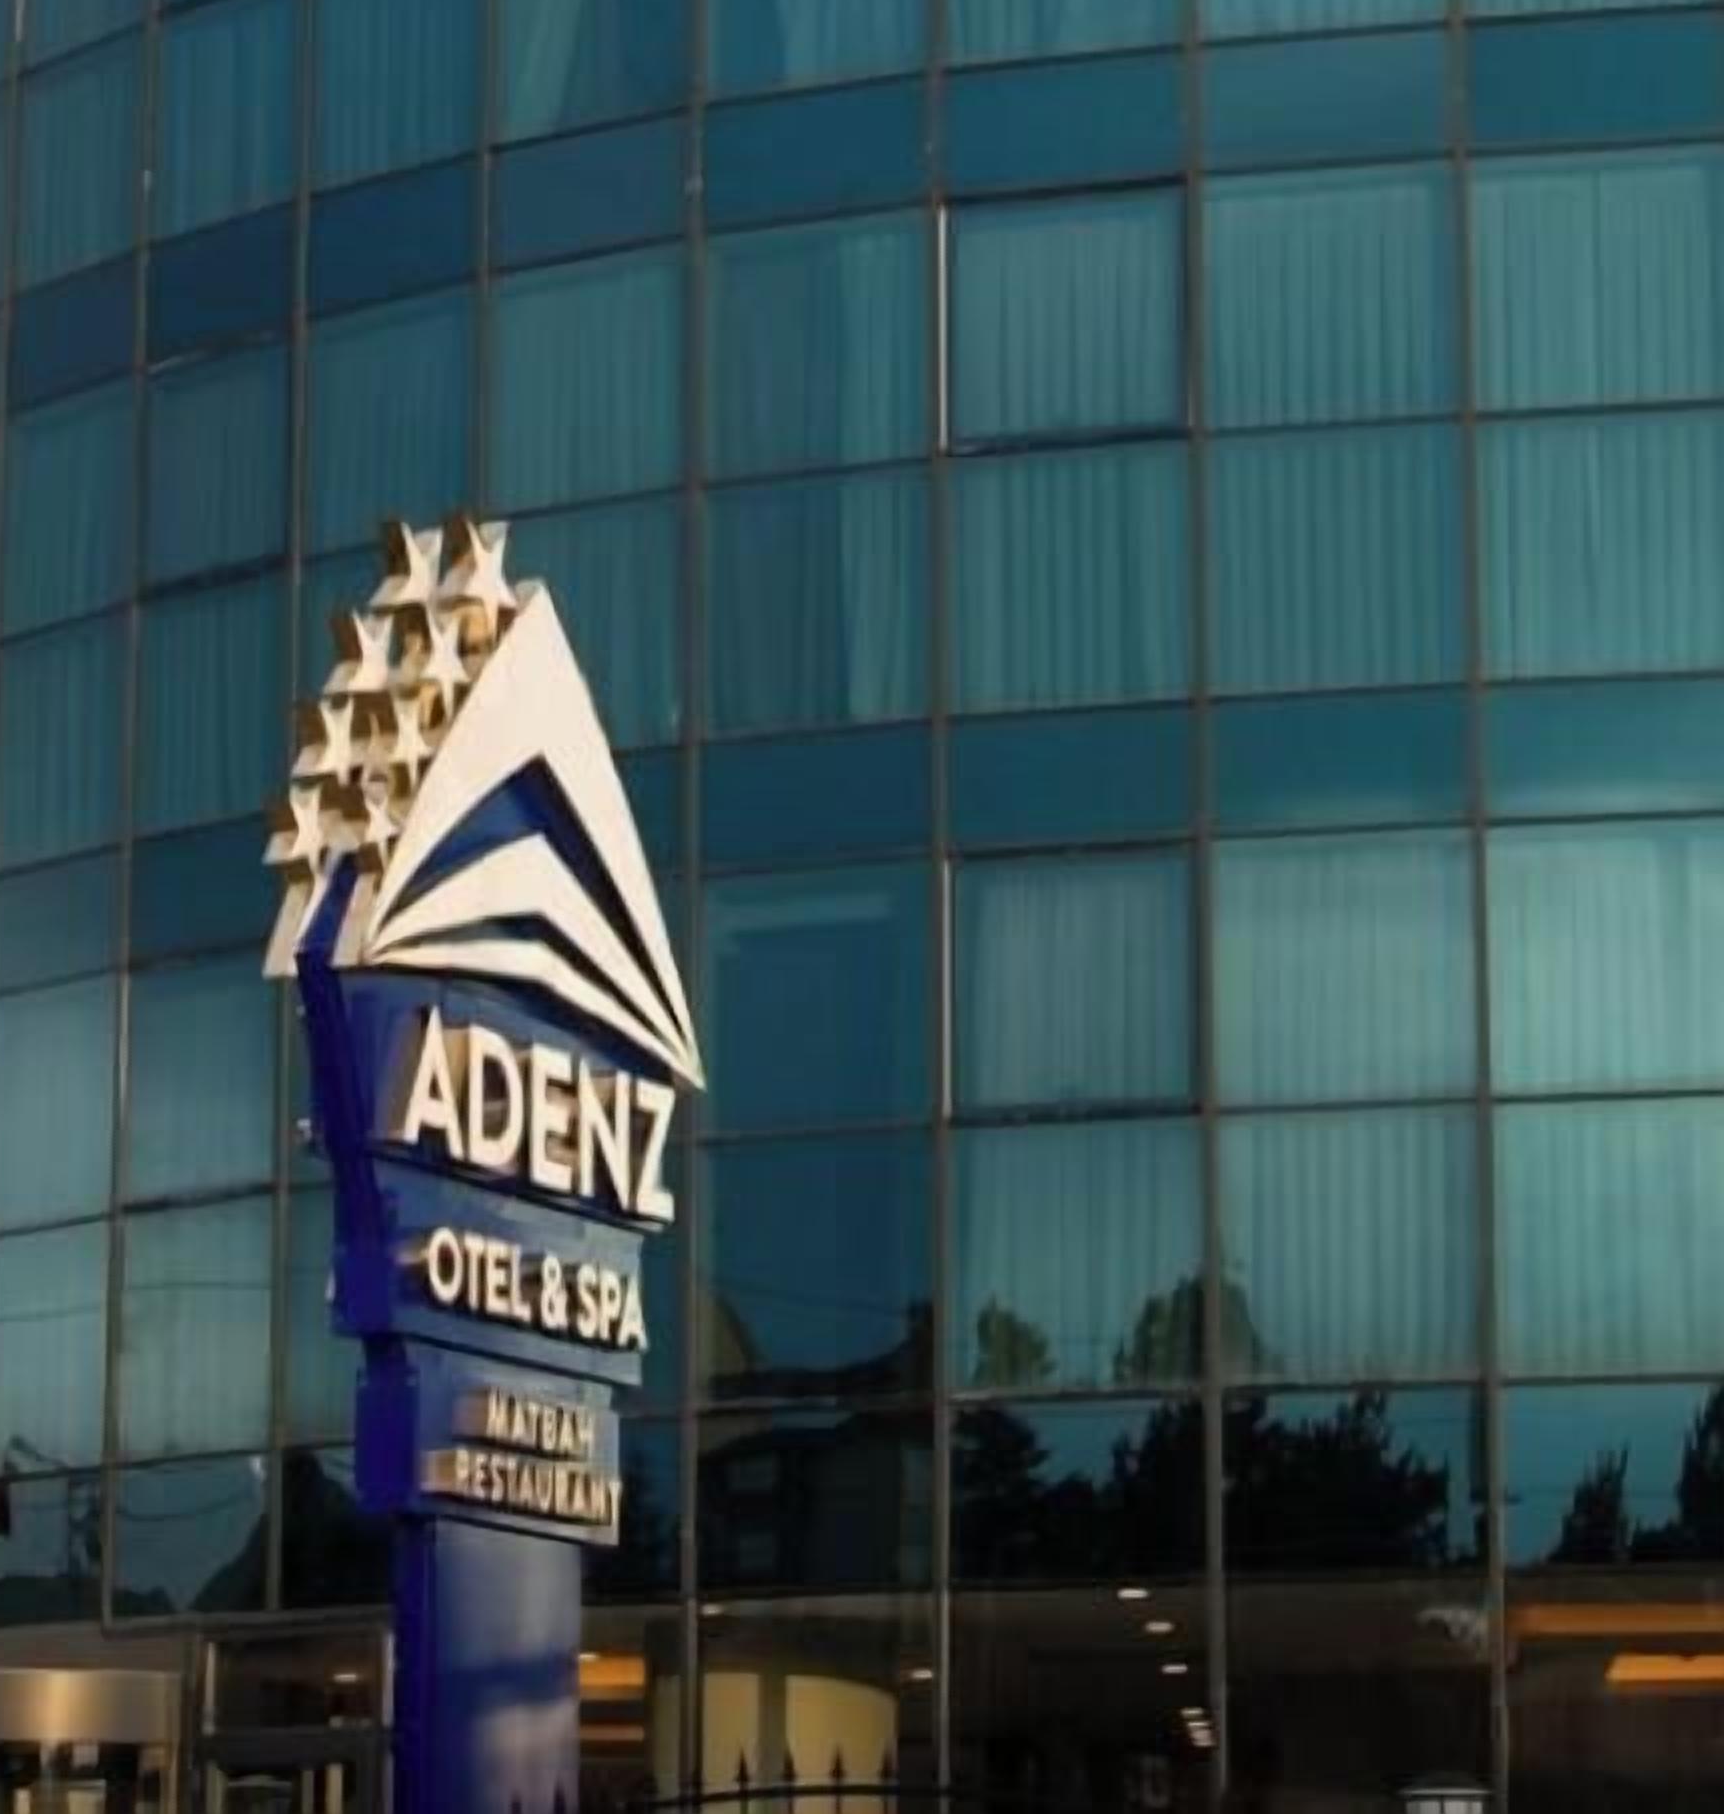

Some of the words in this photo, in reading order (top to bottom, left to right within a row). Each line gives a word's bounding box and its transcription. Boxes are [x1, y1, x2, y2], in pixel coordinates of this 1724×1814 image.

[403, 1005, 676, 1223] ADENZ
[427, 1226, 532, 1324] OTEL
[540, 1253, 570, 1330] &
[577, 1262, 648, 1352] SPA
[486, 1388, 596, 1464] MATBAH
